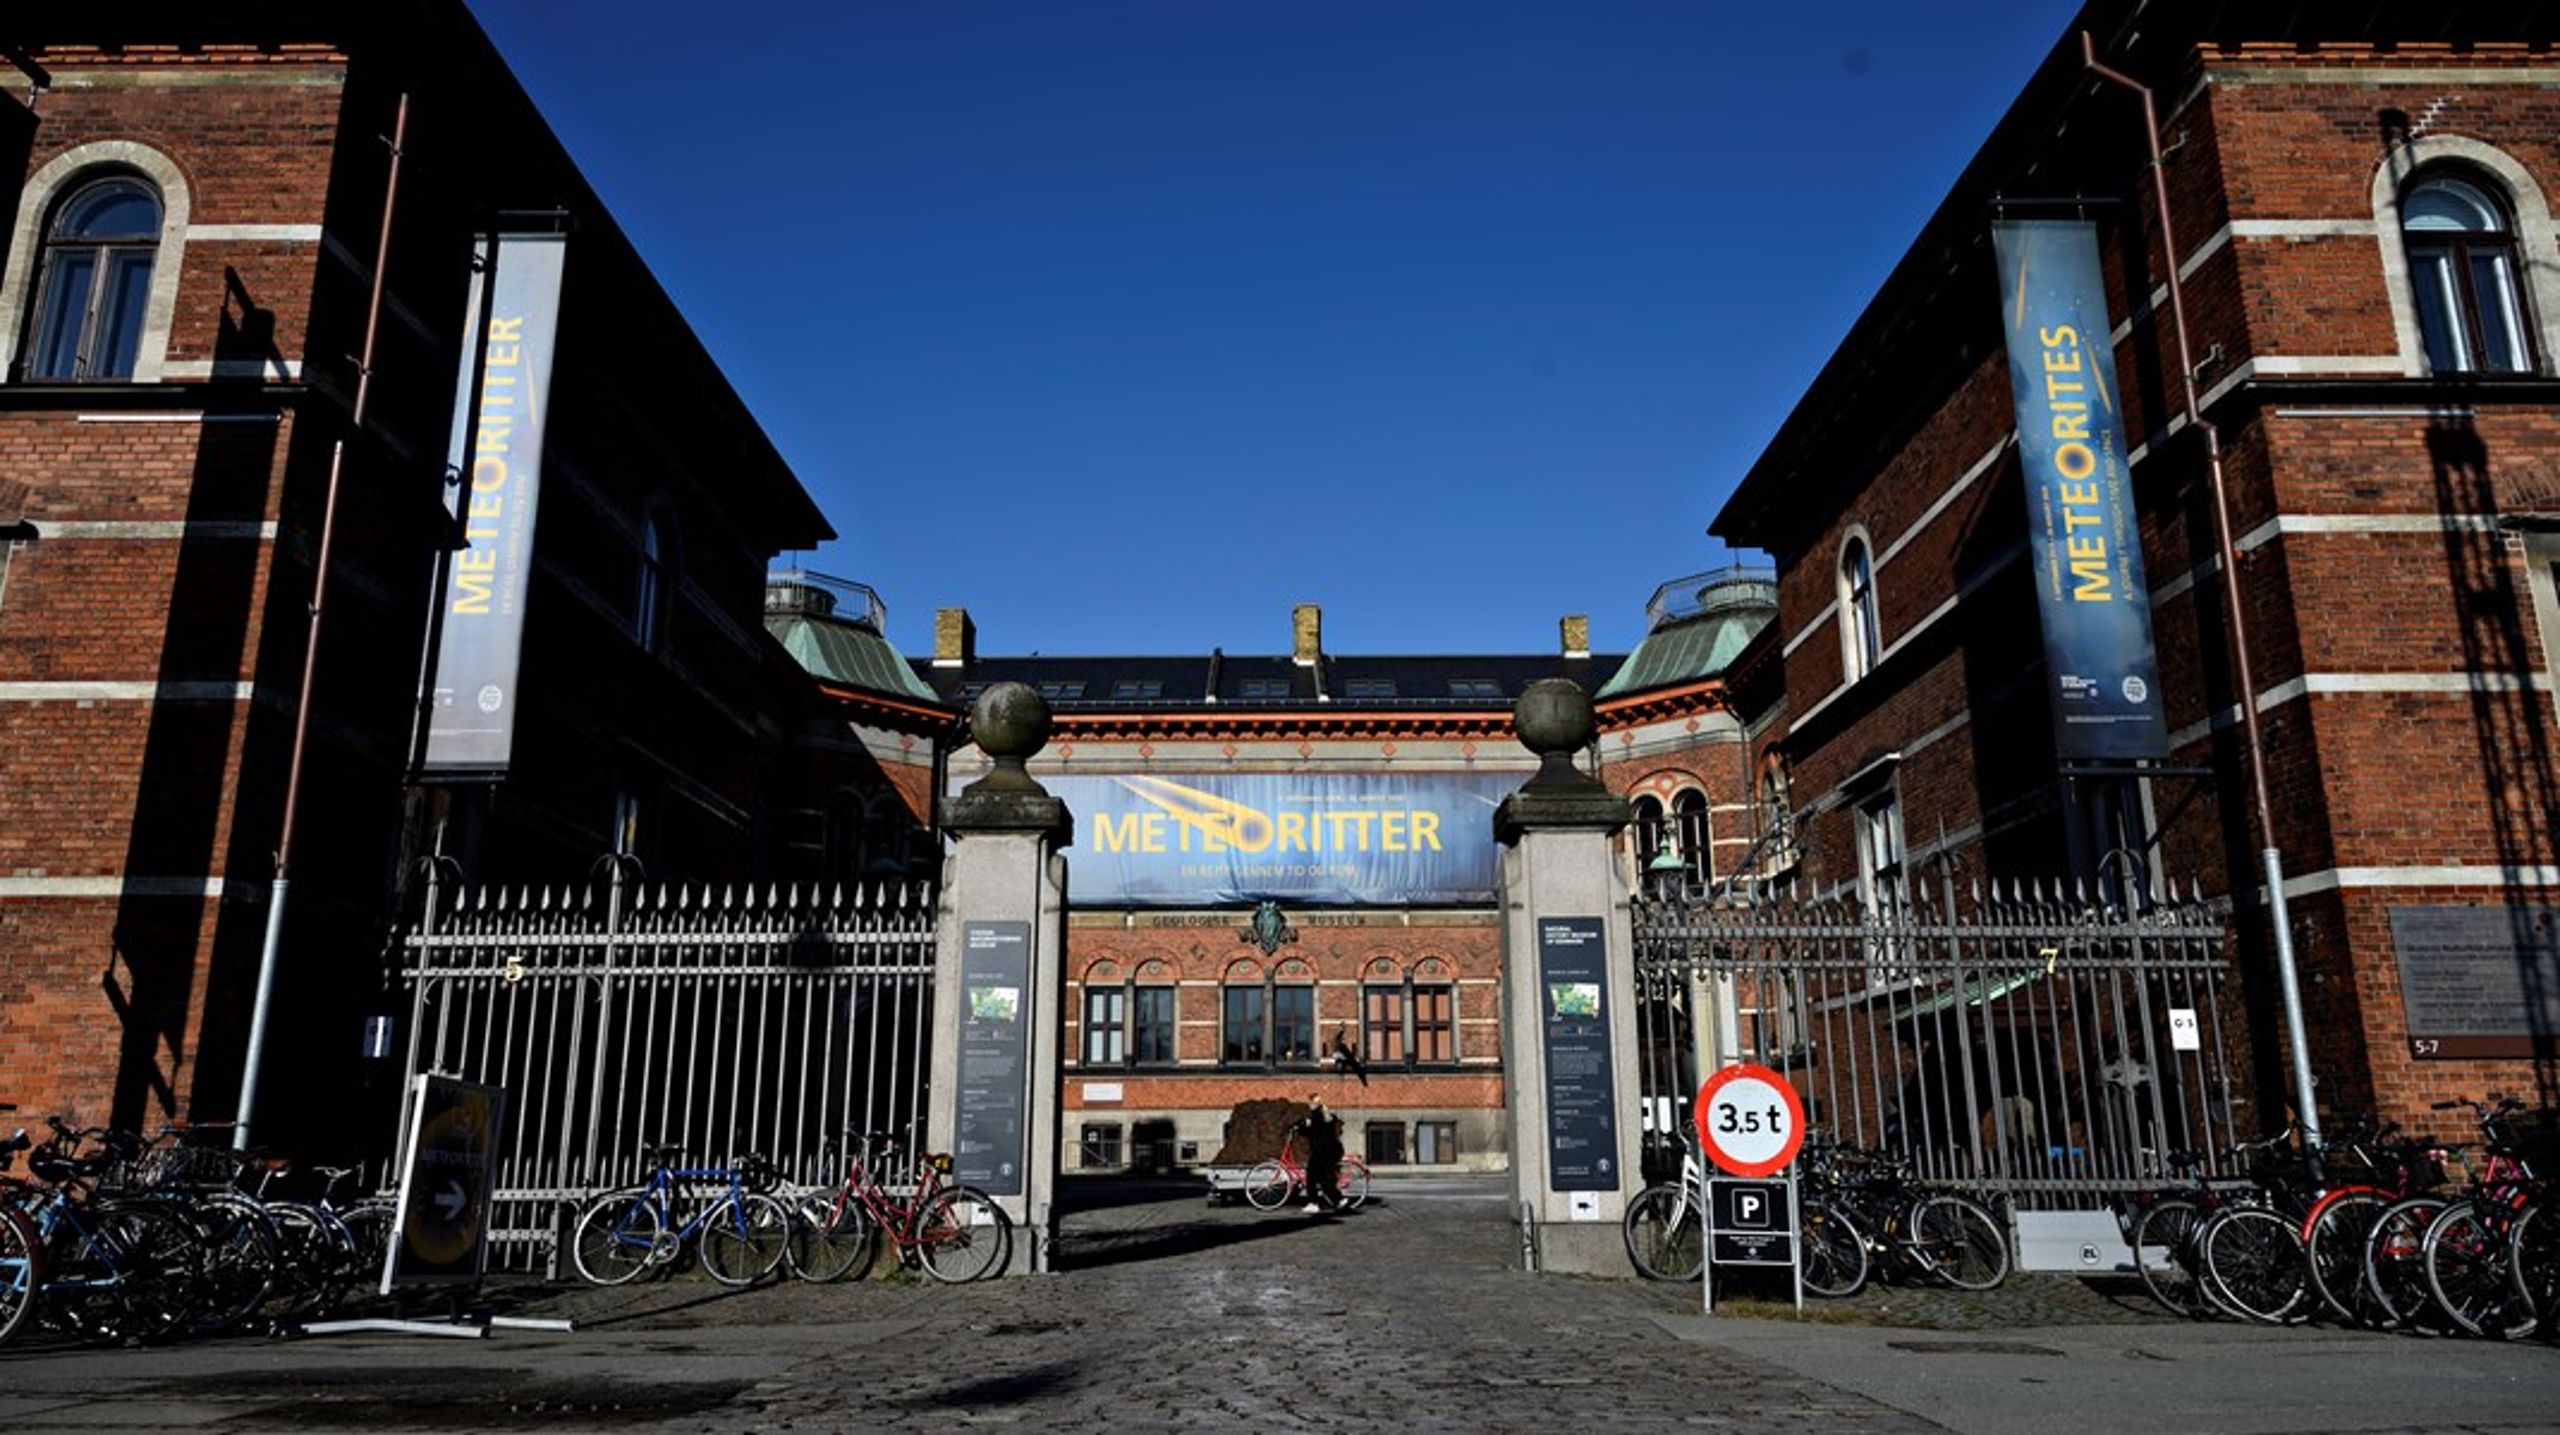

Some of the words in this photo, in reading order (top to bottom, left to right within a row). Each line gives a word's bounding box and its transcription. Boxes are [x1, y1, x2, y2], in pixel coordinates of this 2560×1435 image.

[451, 315, 524, 616] METEORITTER
[2040, 324, 2112, 602] METEORITES
[1093, 809, 1442, 854] METEORITTER
[504, 955, 524, 983] 5
[2040, 948, 2058, 974] 7
[2414, 1039, 2440, 1054] 5-7
[1766, 1104, 1782, 1134] t
[1741, 1195, 1760, 1219] P
